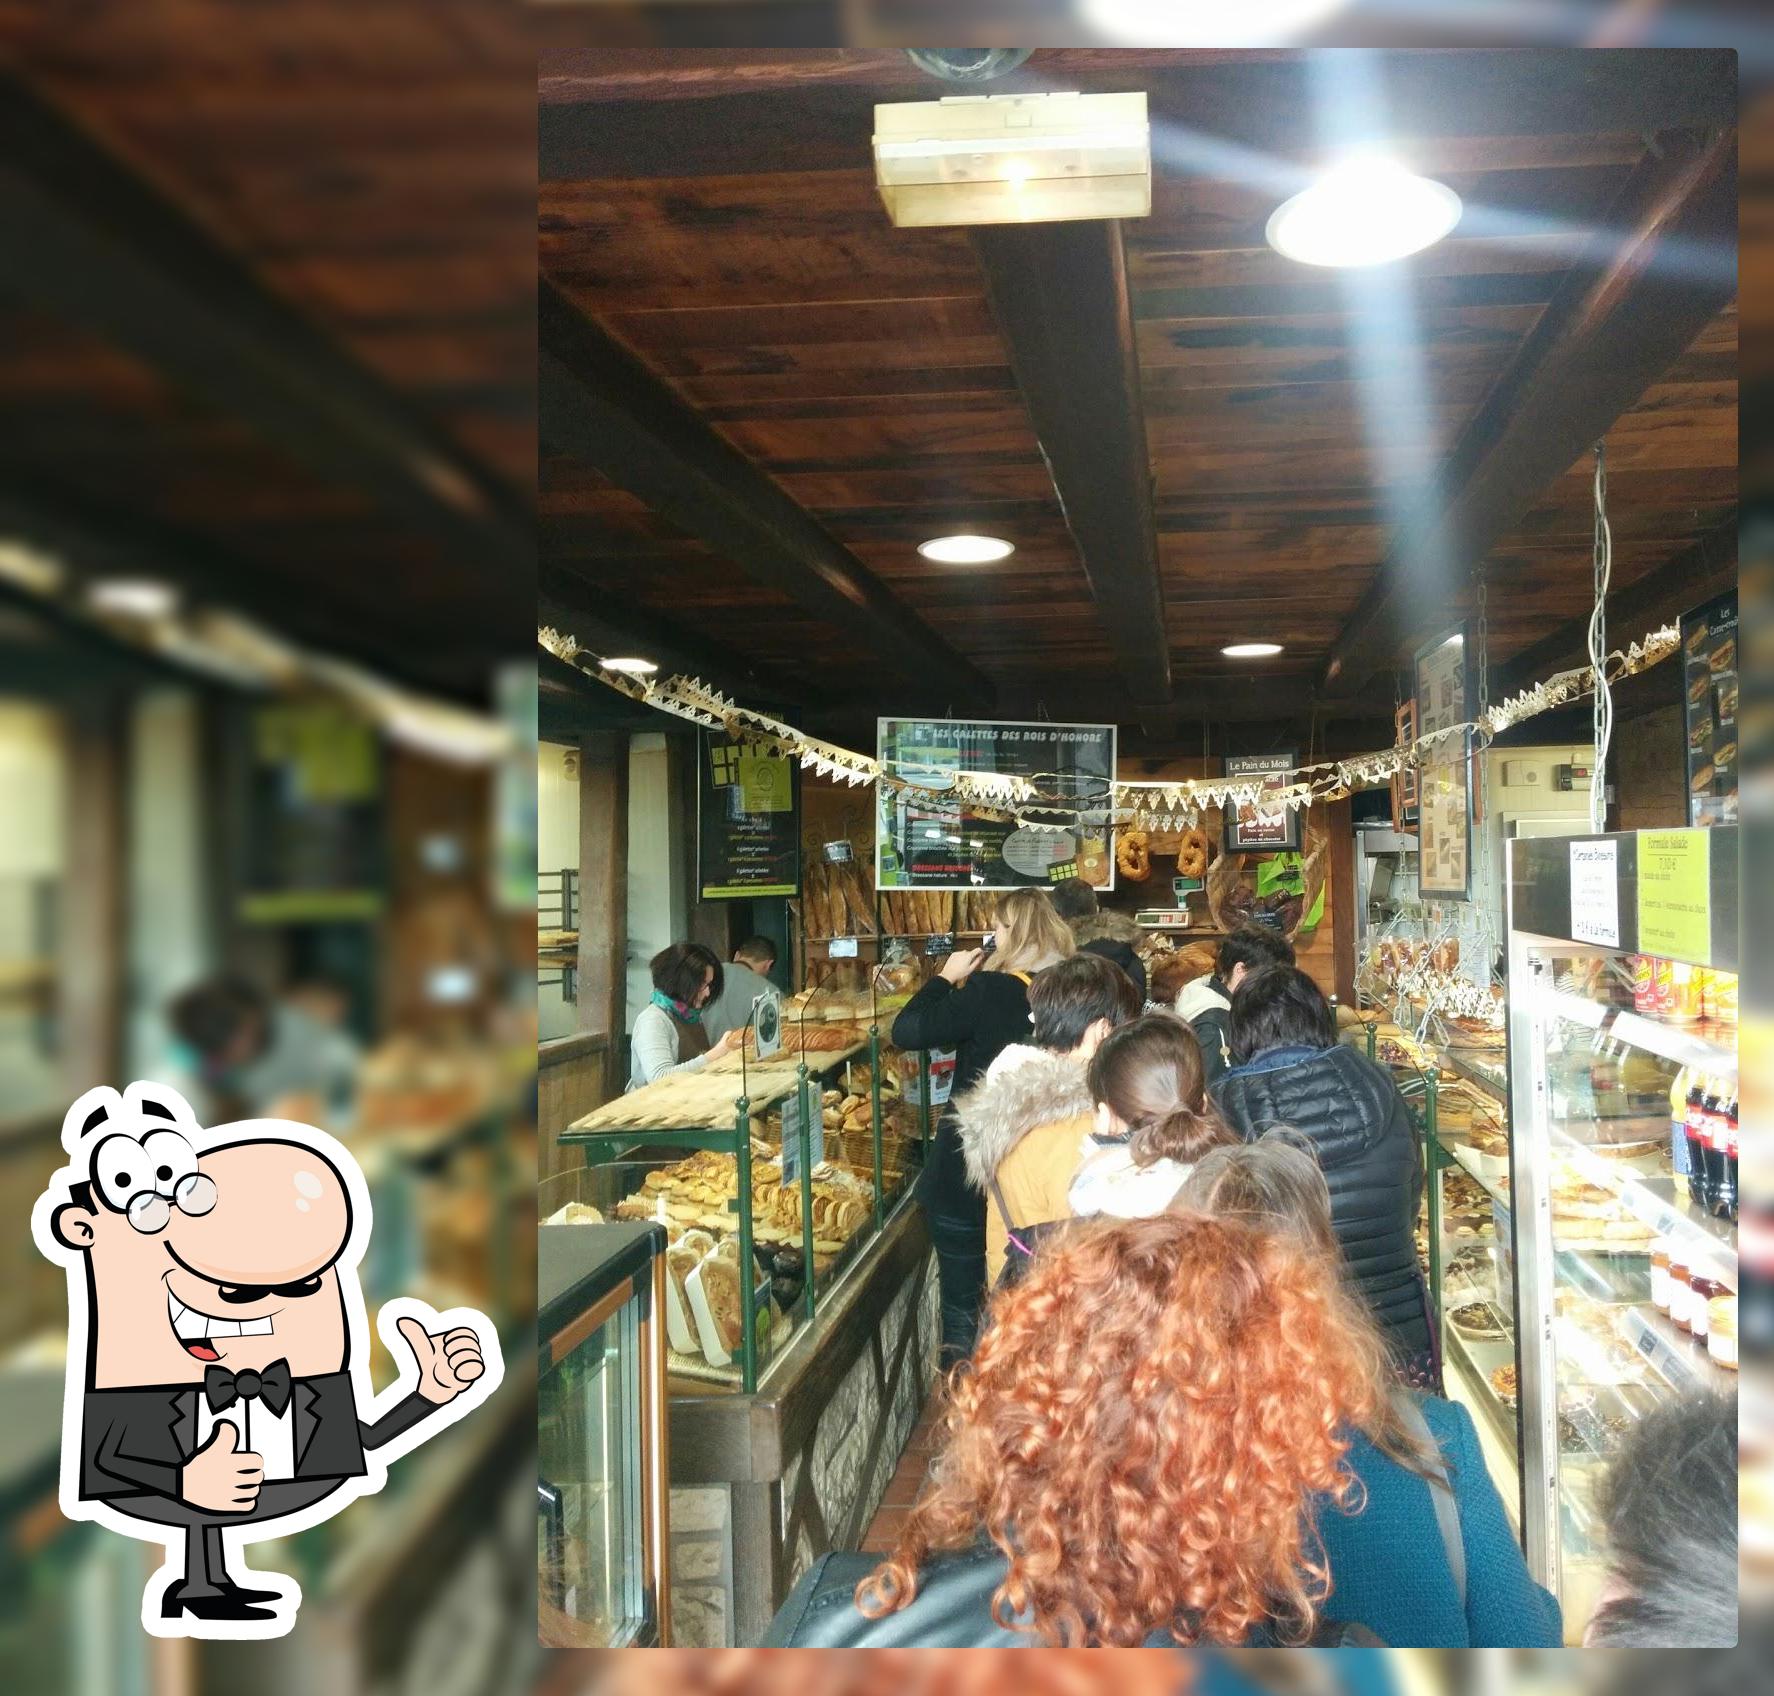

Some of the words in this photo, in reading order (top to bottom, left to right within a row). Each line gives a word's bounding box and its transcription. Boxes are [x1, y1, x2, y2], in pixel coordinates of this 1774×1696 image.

[932, 729, 949, 739] LES
[952, 730, 999, 740] GALETTES
[1001, 730, 1020, 740] DES
[1023, 732, 1047, 742] ROIS
[1229, 762, 1240, 771] Le
[1241, 761, 1258, 770] Pain
[1259, 760, 1270, 769] du
[1271, 759, 1289, 768] Mois
